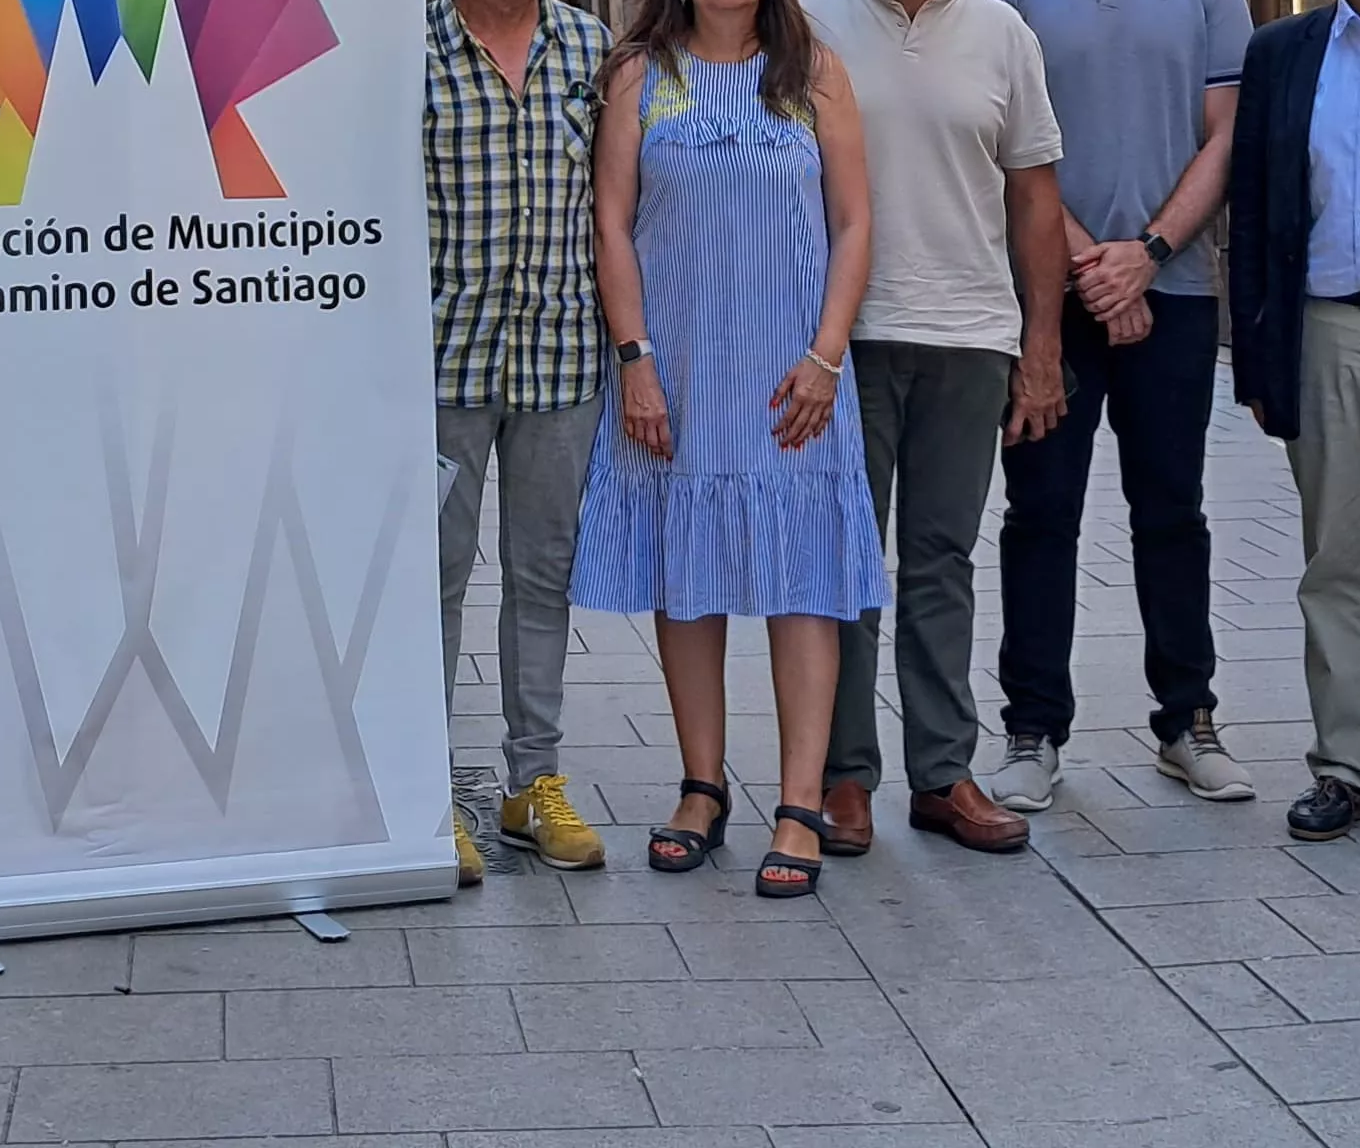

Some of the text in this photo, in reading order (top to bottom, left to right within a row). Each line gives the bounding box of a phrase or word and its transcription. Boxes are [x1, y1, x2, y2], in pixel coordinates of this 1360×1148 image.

[104, 213, 154, 252] de
[168, 210, 382, 256] Municipios
[130, 268, 179, 307] de
[192, 265, 367, 310] Santiago
